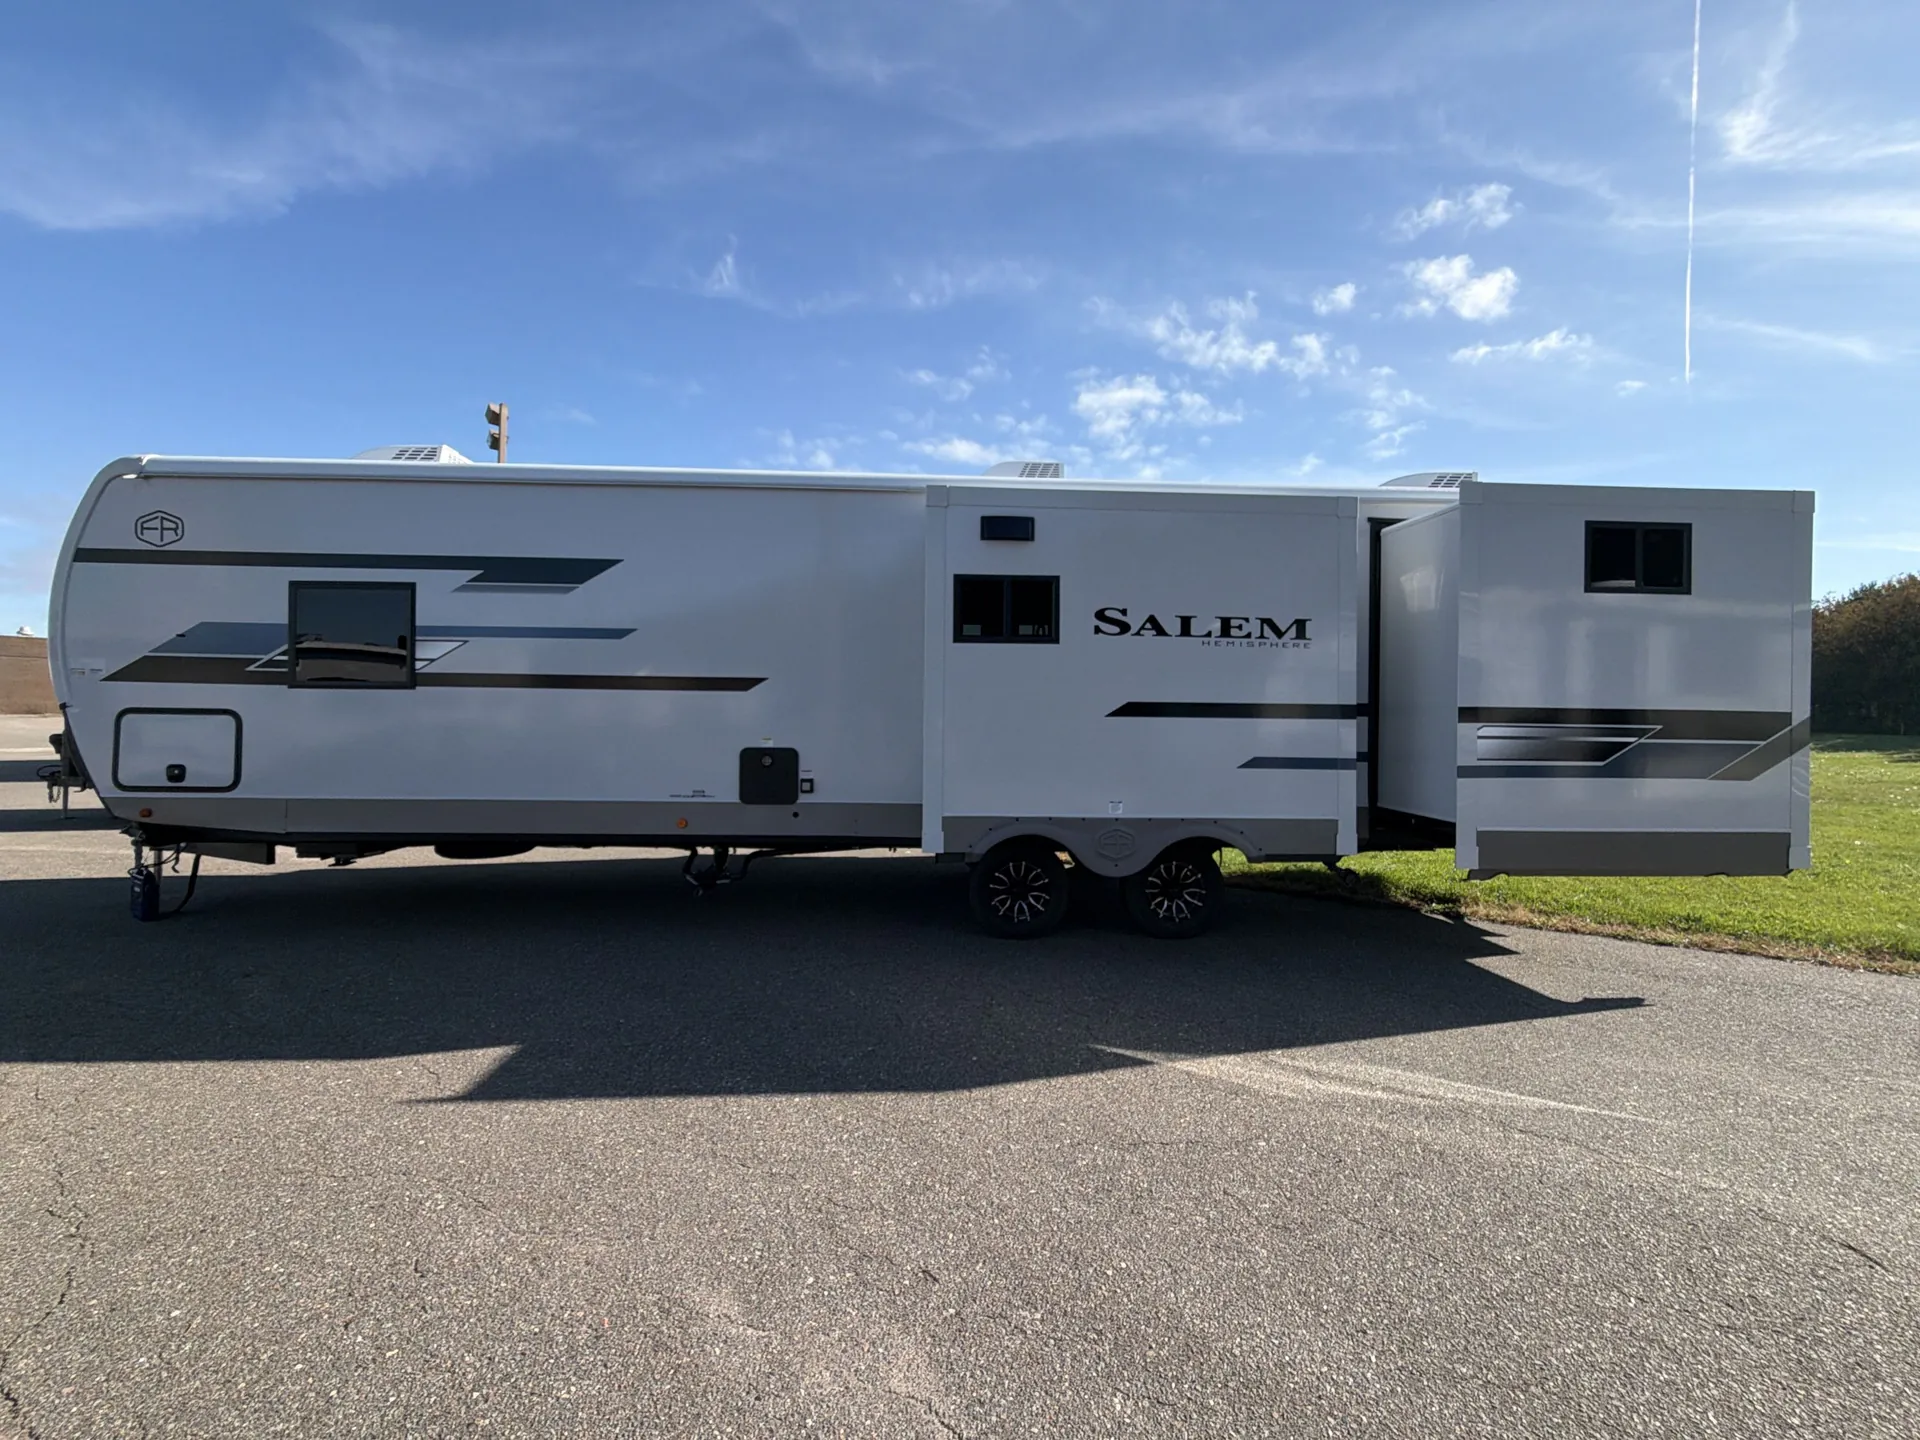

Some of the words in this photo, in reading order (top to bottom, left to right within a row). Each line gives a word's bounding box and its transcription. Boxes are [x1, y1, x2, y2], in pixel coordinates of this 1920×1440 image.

[140, 515, 179, 542] FR
[1093, 607, 1313, 640] SALEM
[1201, 640, 1311, 649] HEMISPHERE
